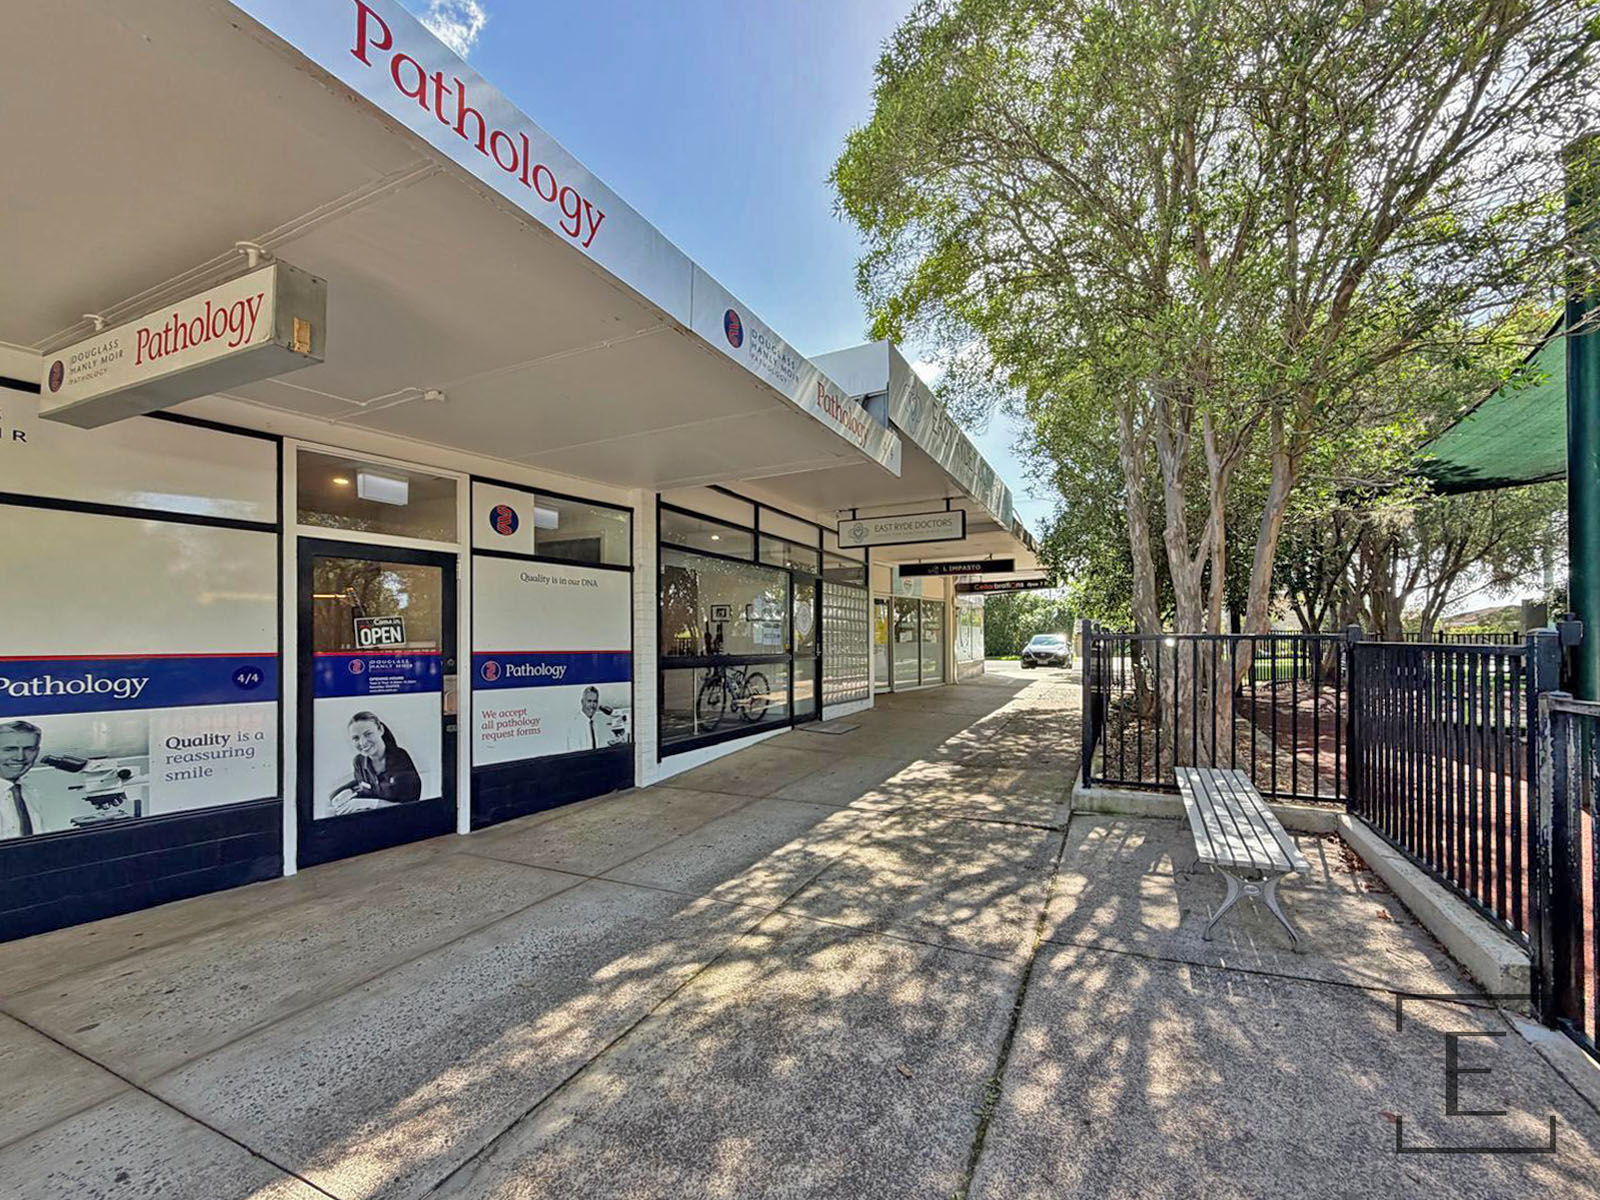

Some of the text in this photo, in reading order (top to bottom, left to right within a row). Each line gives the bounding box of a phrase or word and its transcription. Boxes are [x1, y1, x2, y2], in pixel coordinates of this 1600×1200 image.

[350, 0, 605, 248] Pathology
[134, 293, 264, 366] Pathology
[71, 339, 119, 363] DOUGLASS
[751, 328, 796, 370] DOUGLASS
[751, 343, 778, 366] HANLY
[70, 349, 124, 375] HANLY MOIR
[816, 381, 868, 448] Pathology
[874, 524, 893, 533] EAST
[894, 521, 913, 531] RYDE
[914, 518, 953, 529] DOCTORS
[520, 572, 550, 584] Quality
[559, 577, 567, 585] in
[581, 579, 598, 587] DNA
[360, 626, 402, 645] OPEN
[506, 663, 566, 679] Pathology
[0, 672, 260, 700] Pathology 4/4
[481, 708, 527, 719] We accept
[481, 717, 541, 731] all pathology
[165, 730, 264, 751] Quality is a
[481, 727, 541, 742] request forms
[165, 746, 256, 766] reassuring
[165, 766, 213, 782] smile
